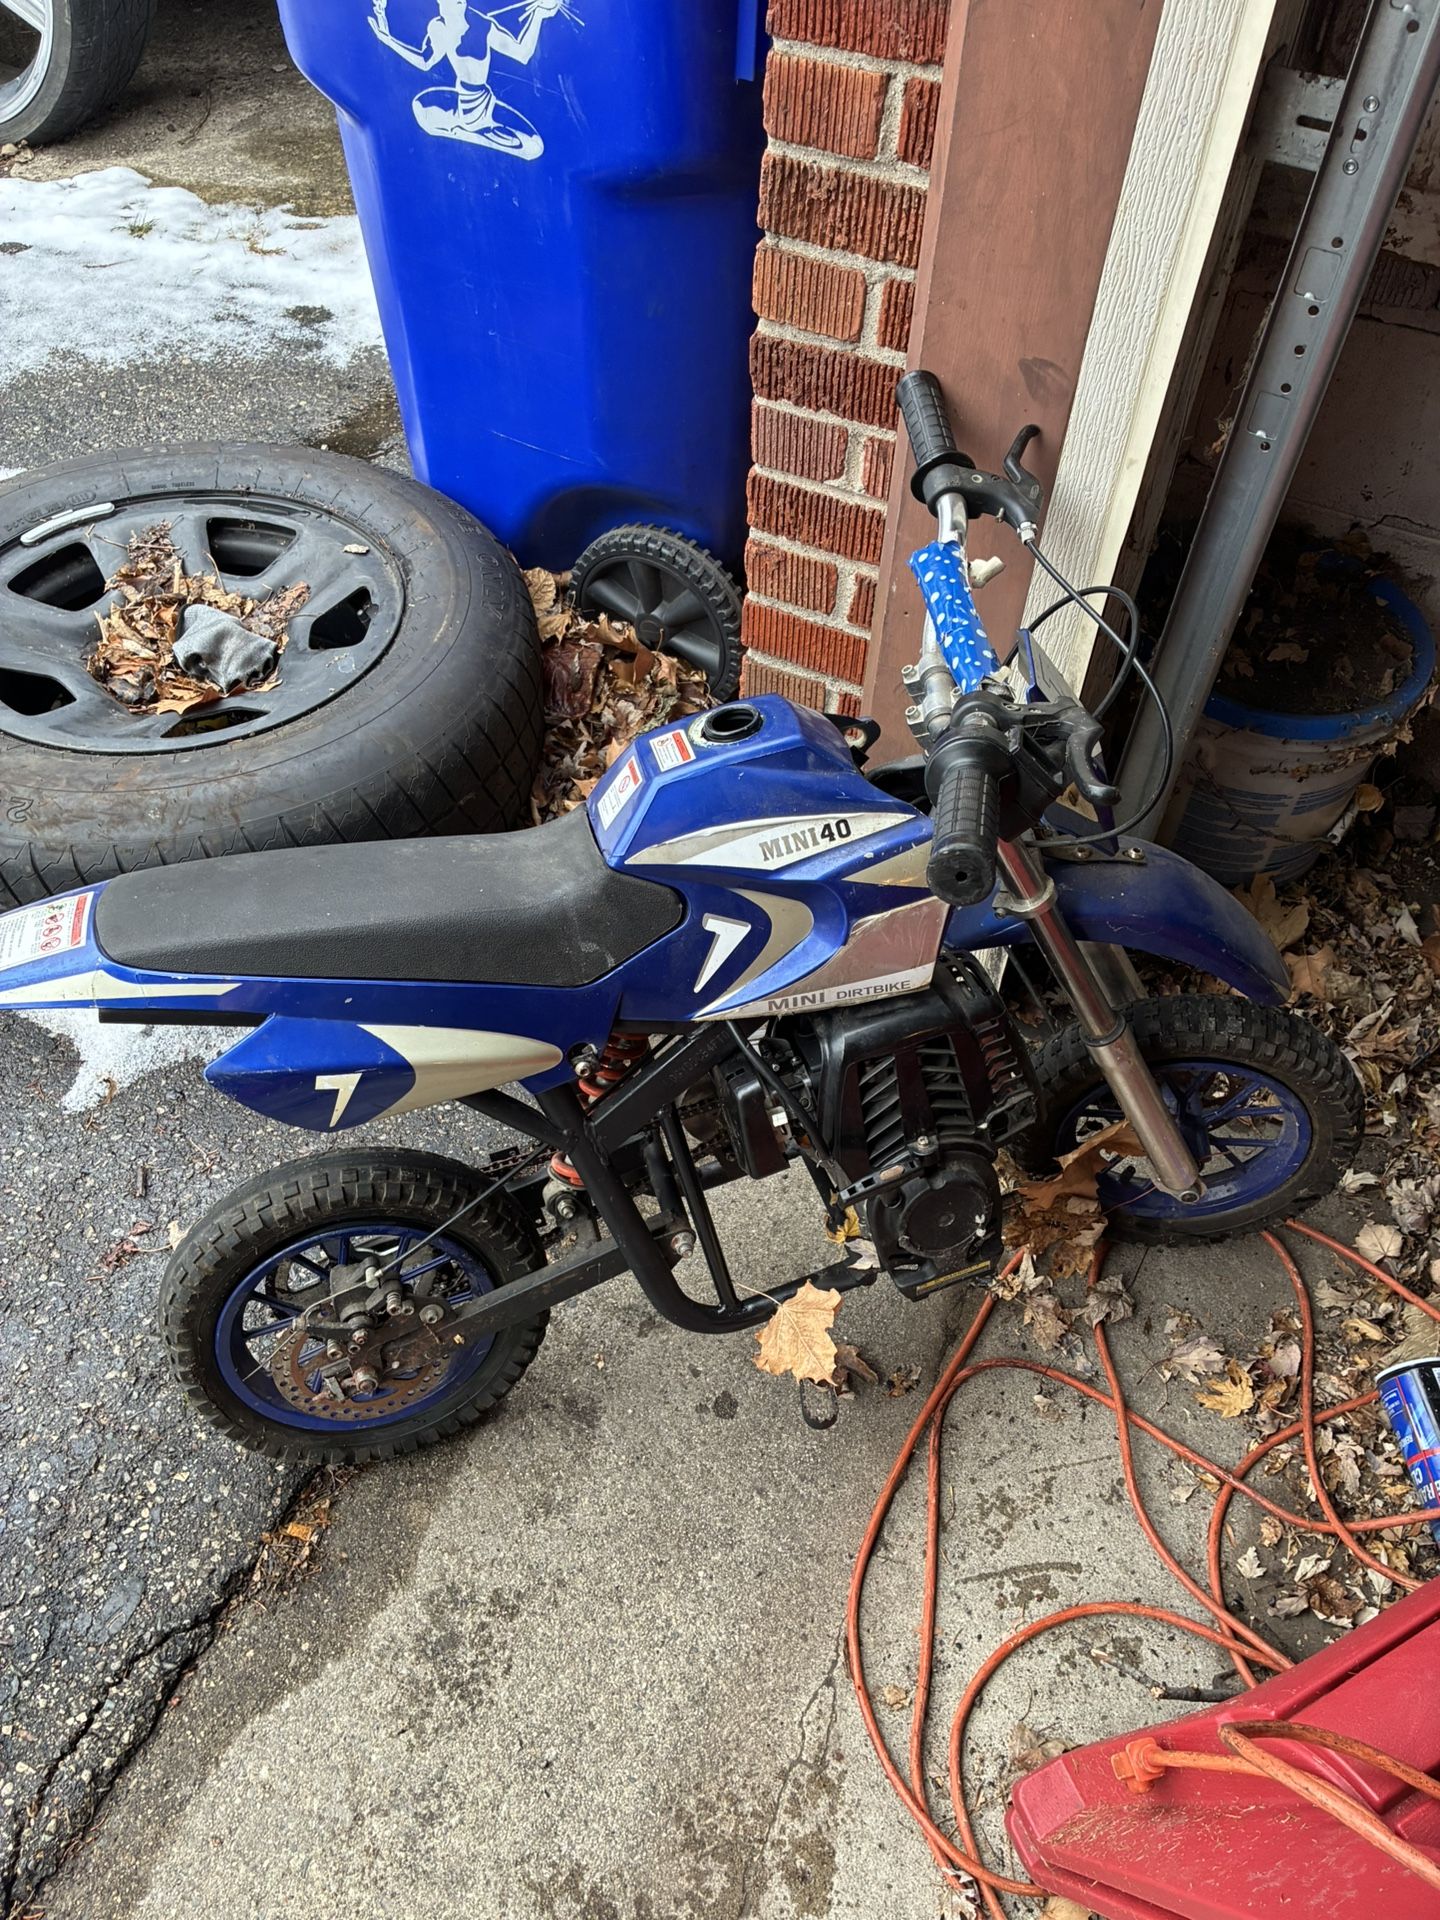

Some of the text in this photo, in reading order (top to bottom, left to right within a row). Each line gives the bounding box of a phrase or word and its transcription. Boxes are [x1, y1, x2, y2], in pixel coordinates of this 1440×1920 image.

[476, 552, 508, 625] ONLY
[694, 913, 751, 993] 7
[767, 979, 912, 1011] MINI DIRTBIKE
[314, 1072, 363, 1128] 7
